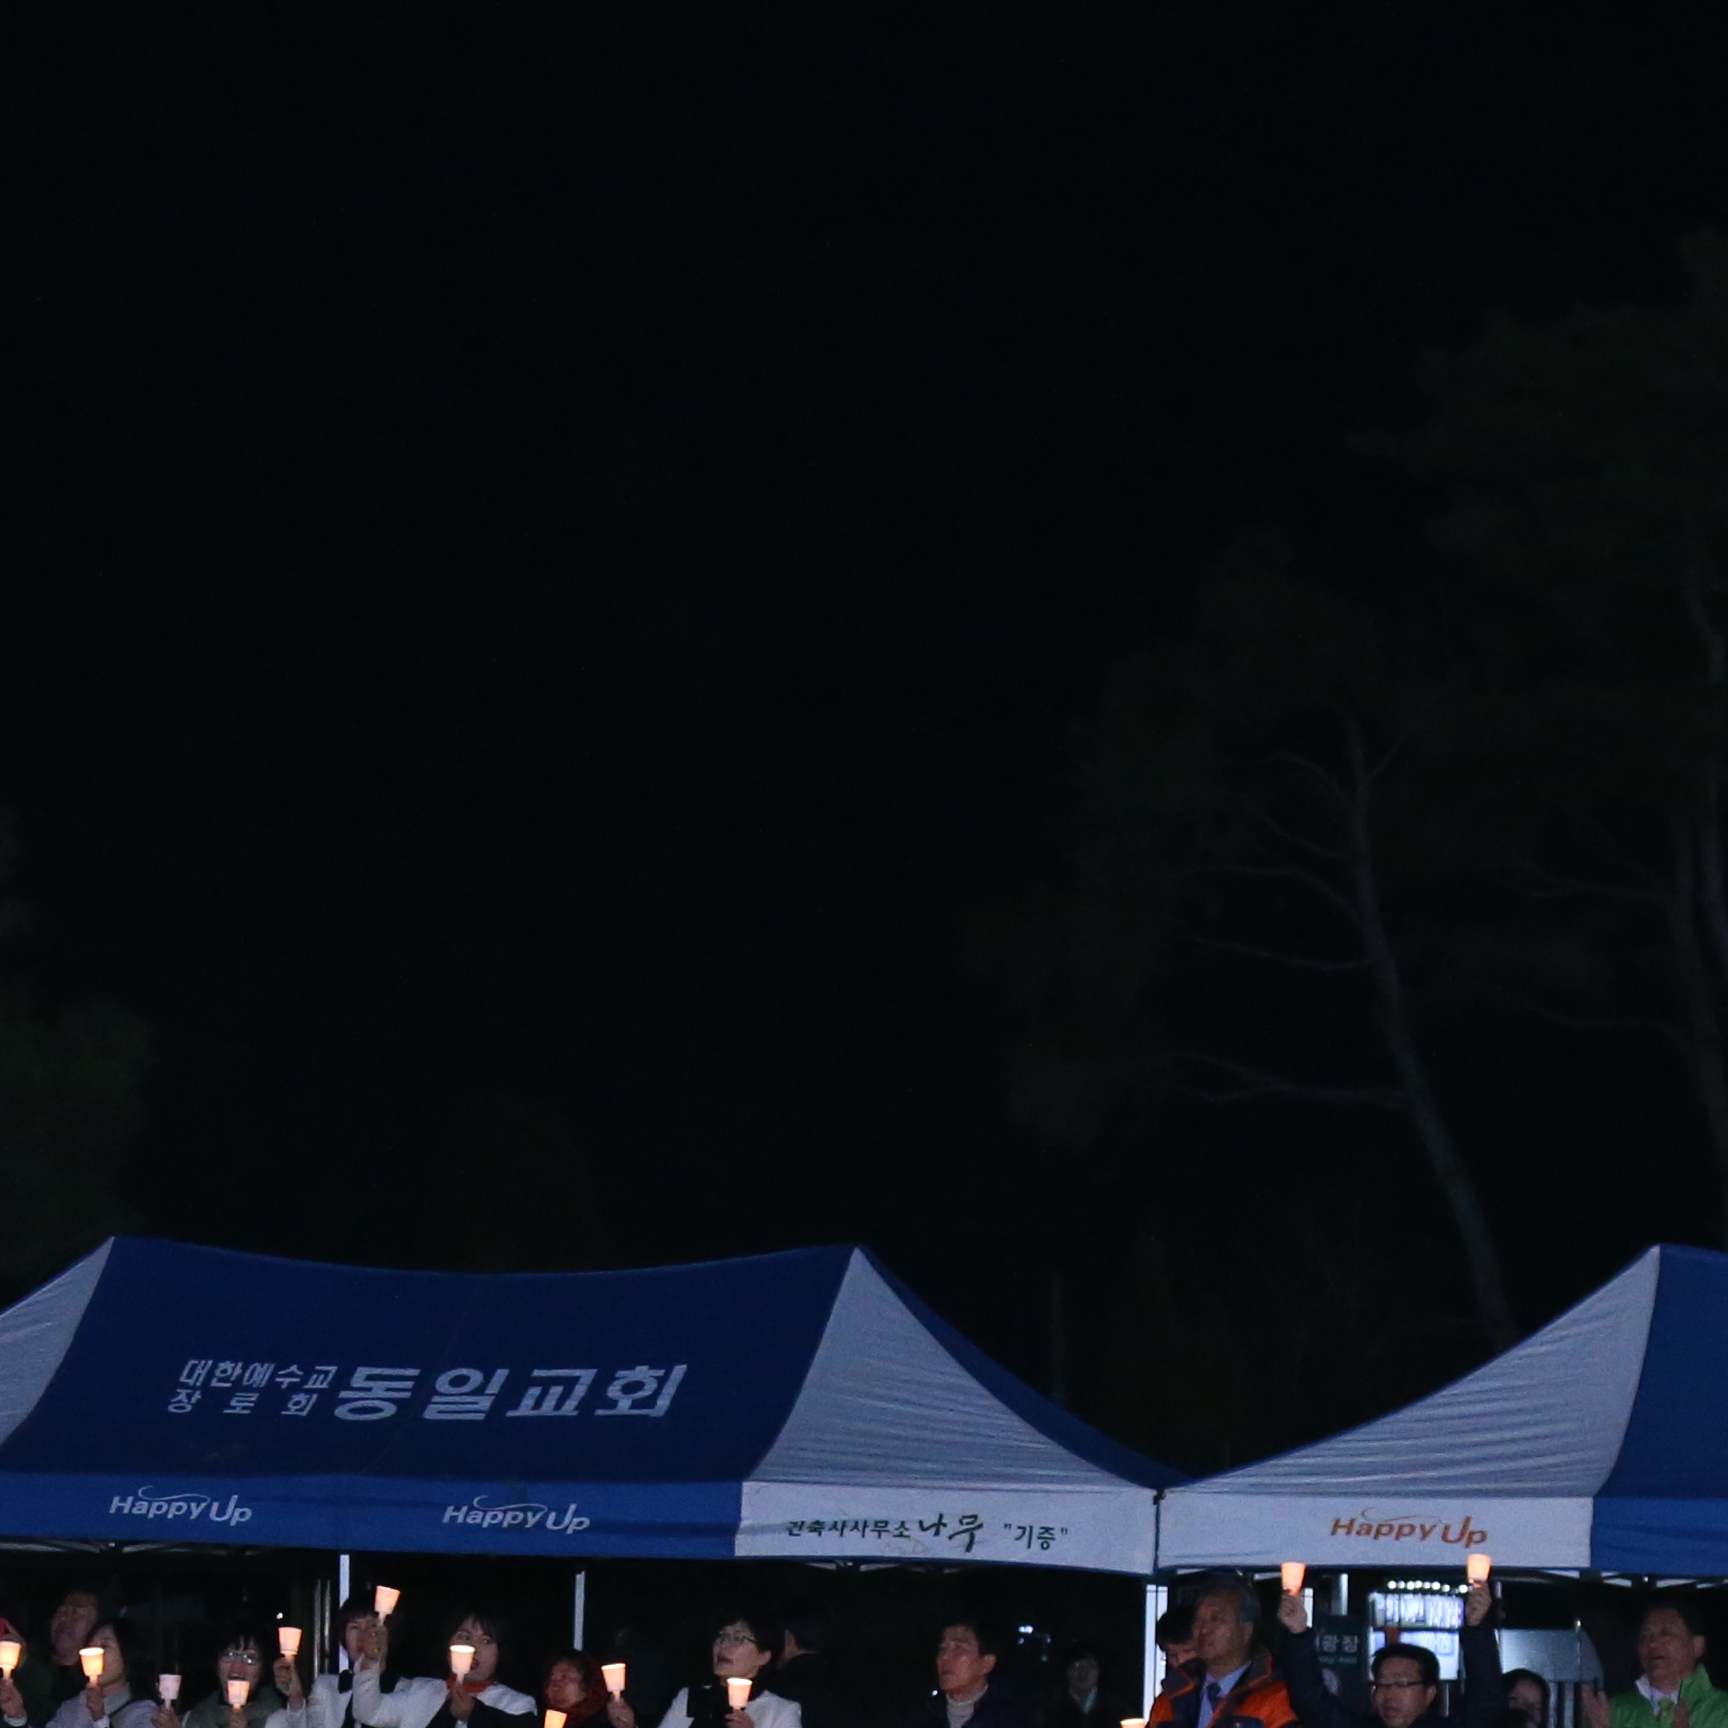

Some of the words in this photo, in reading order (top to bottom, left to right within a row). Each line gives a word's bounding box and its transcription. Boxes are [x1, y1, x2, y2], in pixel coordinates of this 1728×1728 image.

[178, 1358, 338, 1389] 대한예수교
[333, 1363, 688, 1421] 동일교회
[109, 1495, 209, 1520] Happy
[209, 1494, 253, 1527] Up
[441, 1505, 545, 1529] Happy
[545, 1503, 591, 1534] Up
[785, 1519, 912, 1539] 건축사사무소
[918, 1513, 984, 1553] 나무
[1330, 1517, 1437, 1541] Happy
[1440, 1515, 1488, 1549] Up
